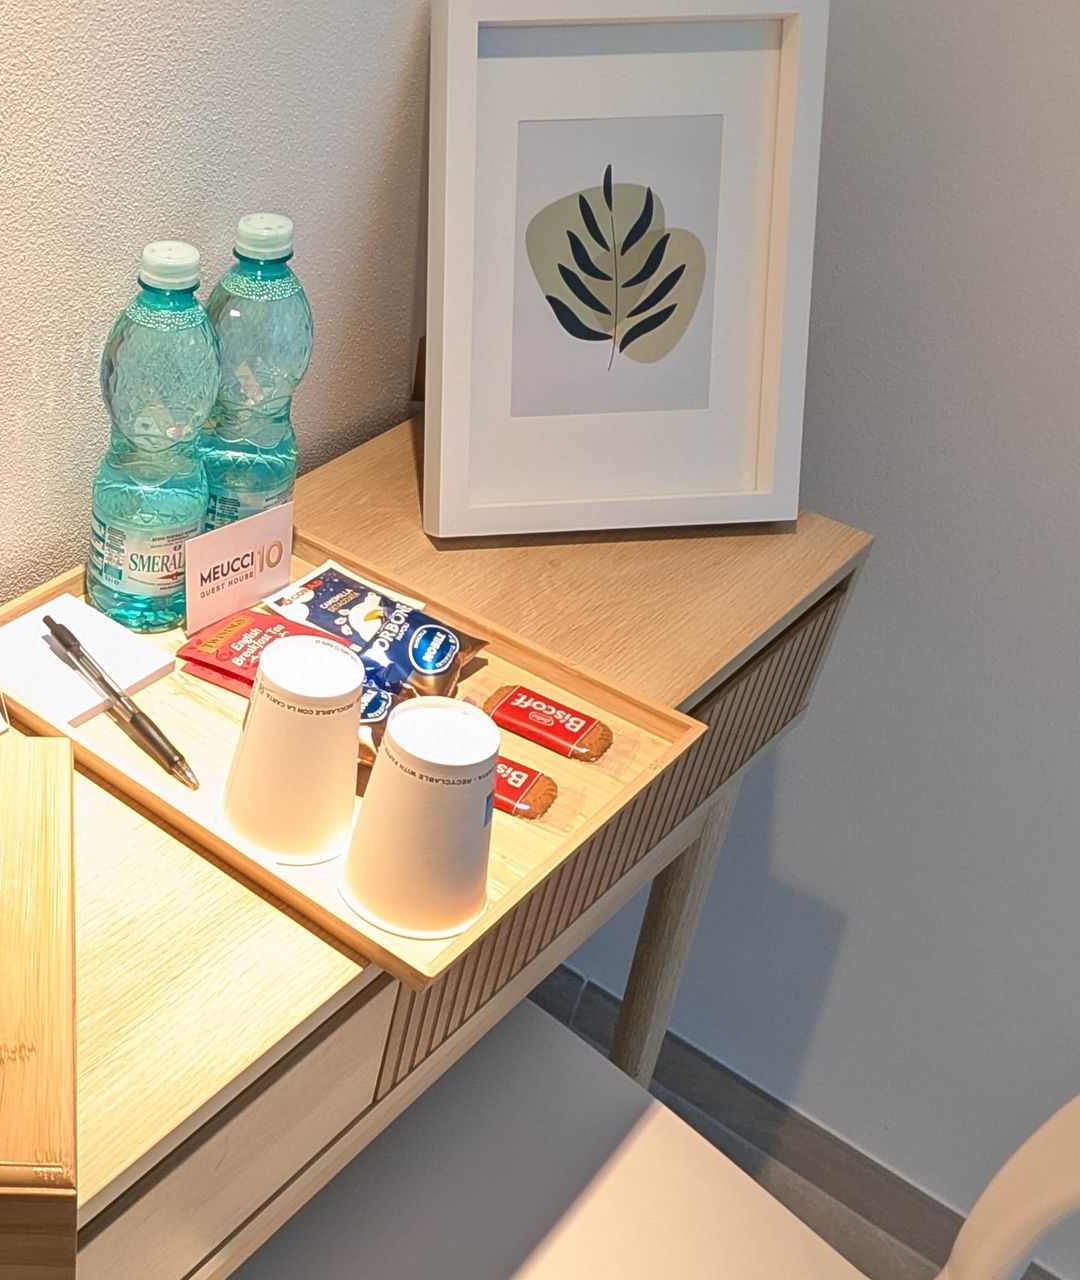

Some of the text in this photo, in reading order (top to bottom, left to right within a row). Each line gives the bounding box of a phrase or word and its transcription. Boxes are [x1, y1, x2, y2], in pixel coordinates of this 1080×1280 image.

[128, 552, 186, 573] SMERAL
[257, 540, 284, 572] 10
[199, 551, 254, 587] MEUCCI
[200, 583, 225, 599] GUEST
[228, 571, 254, 587] HOUSE
[231, 627, 263, 652] English
[268, 624, 286, 638] Tea
[422, 631, 447, 663] NOBILE
[297, 707, 313, 715] CON
[510, 692, 586, 733] Biscoff
[398, 763, 416, 778] WITH
[418, 773, 472, 785] RECYCLABLE
